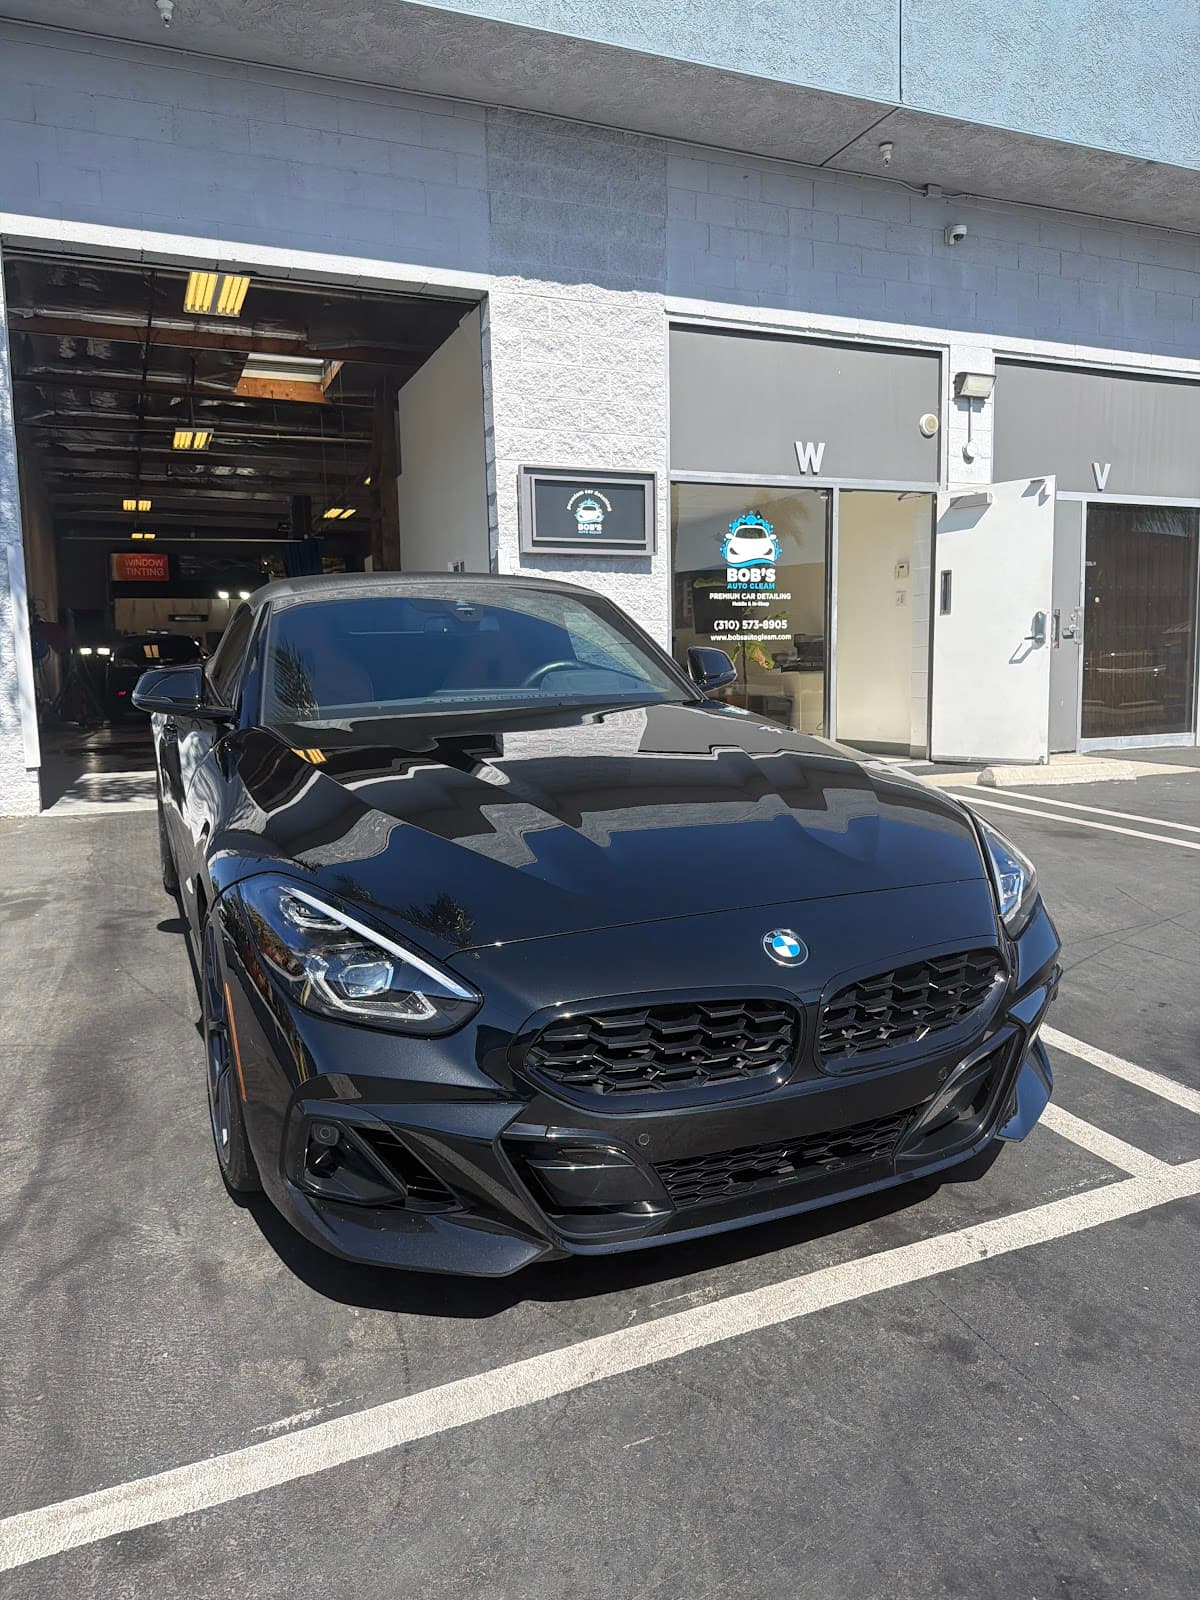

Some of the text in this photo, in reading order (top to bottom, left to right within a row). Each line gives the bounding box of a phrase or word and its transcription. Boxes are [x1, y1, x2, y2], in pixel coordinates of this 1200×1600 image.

[794, 441, 825, 474] W
[1092, 462, 1111, 491] V
[577, 523, 602, 531] BOB'S
[125, 559, 164, 568] WINDOW
[126, 567, 165, 577] TINTING
[726, 567, 776, 583] BOB'S
[709, 592, 792, 600] PREMIUM CAR DETAILING
[713, 619, 788, 631] (310) 573-8905
[710, 633, 792, 642] www.bobsautogleam.com
